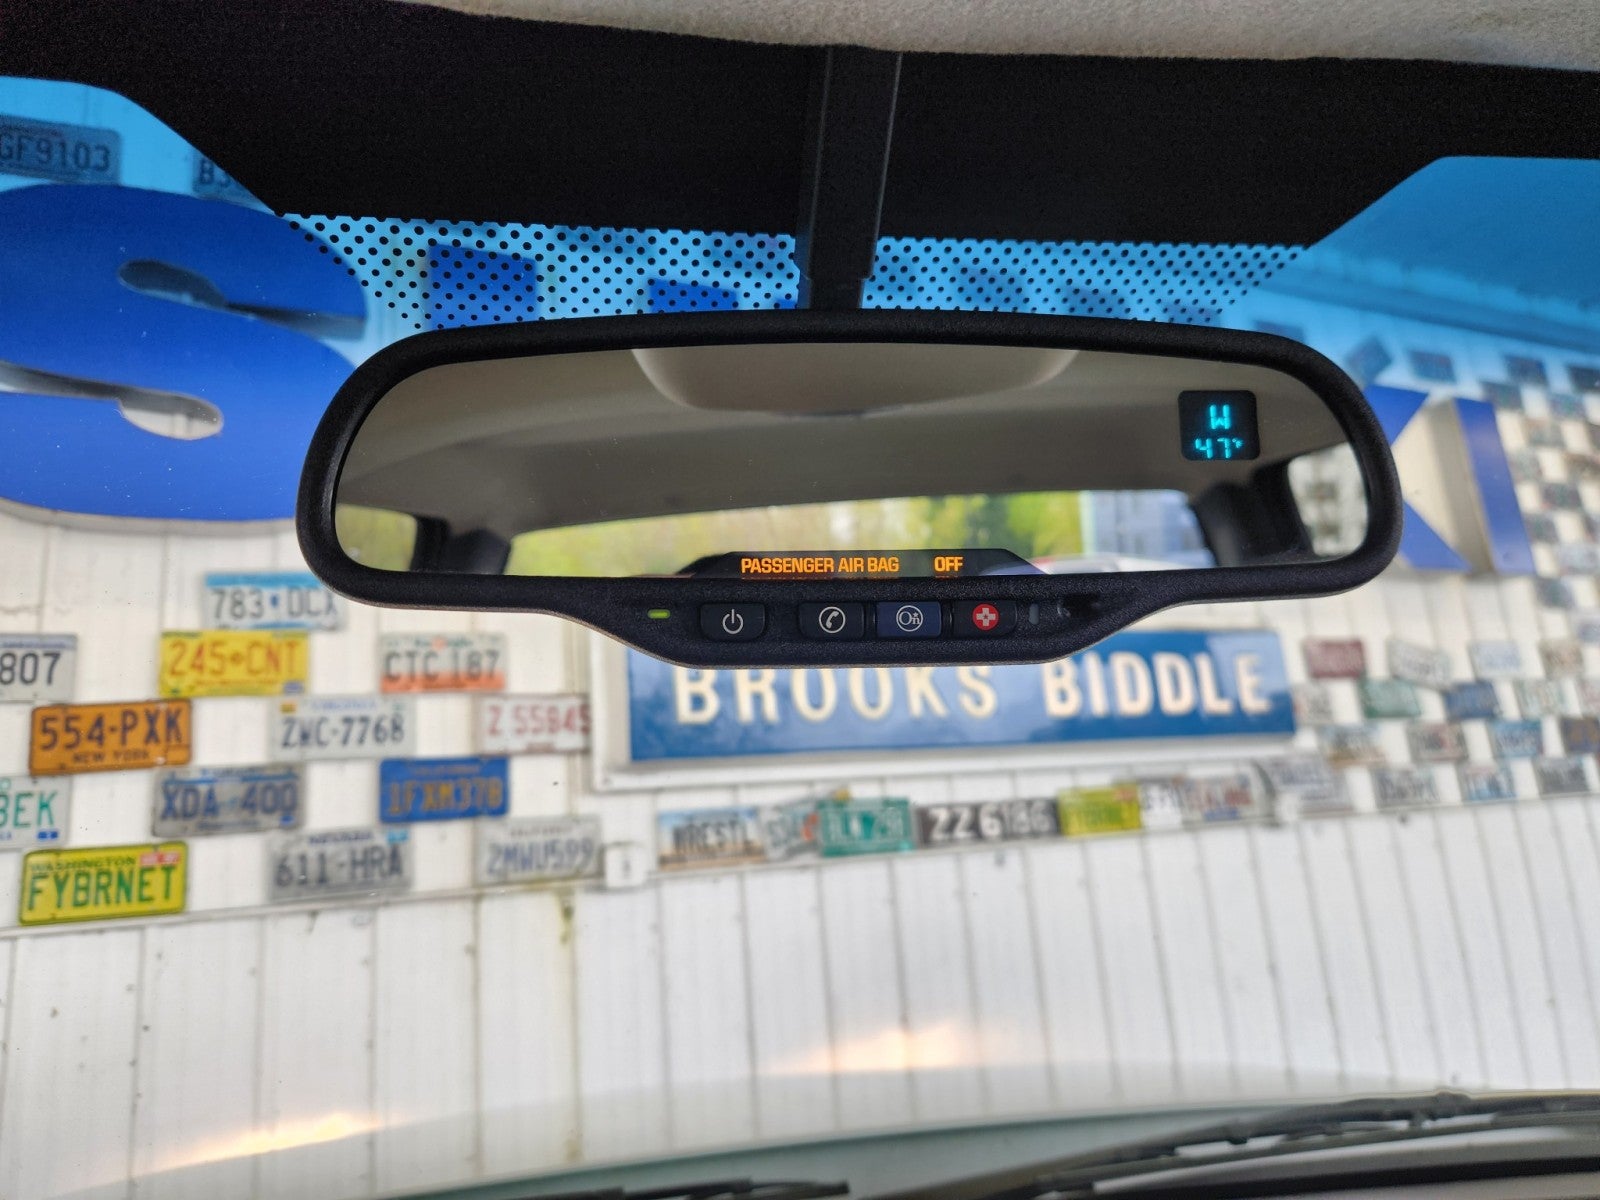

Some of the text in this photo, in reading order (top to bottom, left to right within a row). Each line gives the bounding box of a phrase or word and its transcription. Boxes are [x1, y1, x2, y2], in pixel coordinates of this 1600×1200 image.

[1210, 404, 1231, 430] W
[741, 556, 964, 574] PASSENGER AIR BAG OFF
[673, 650, 1272, 724] BROOKS BIDDLE
[40, 708, 184, 751] 554-PXK
[73, 750, 106, 763] NEW
[27, 864, 177, 911] FYBRNET
